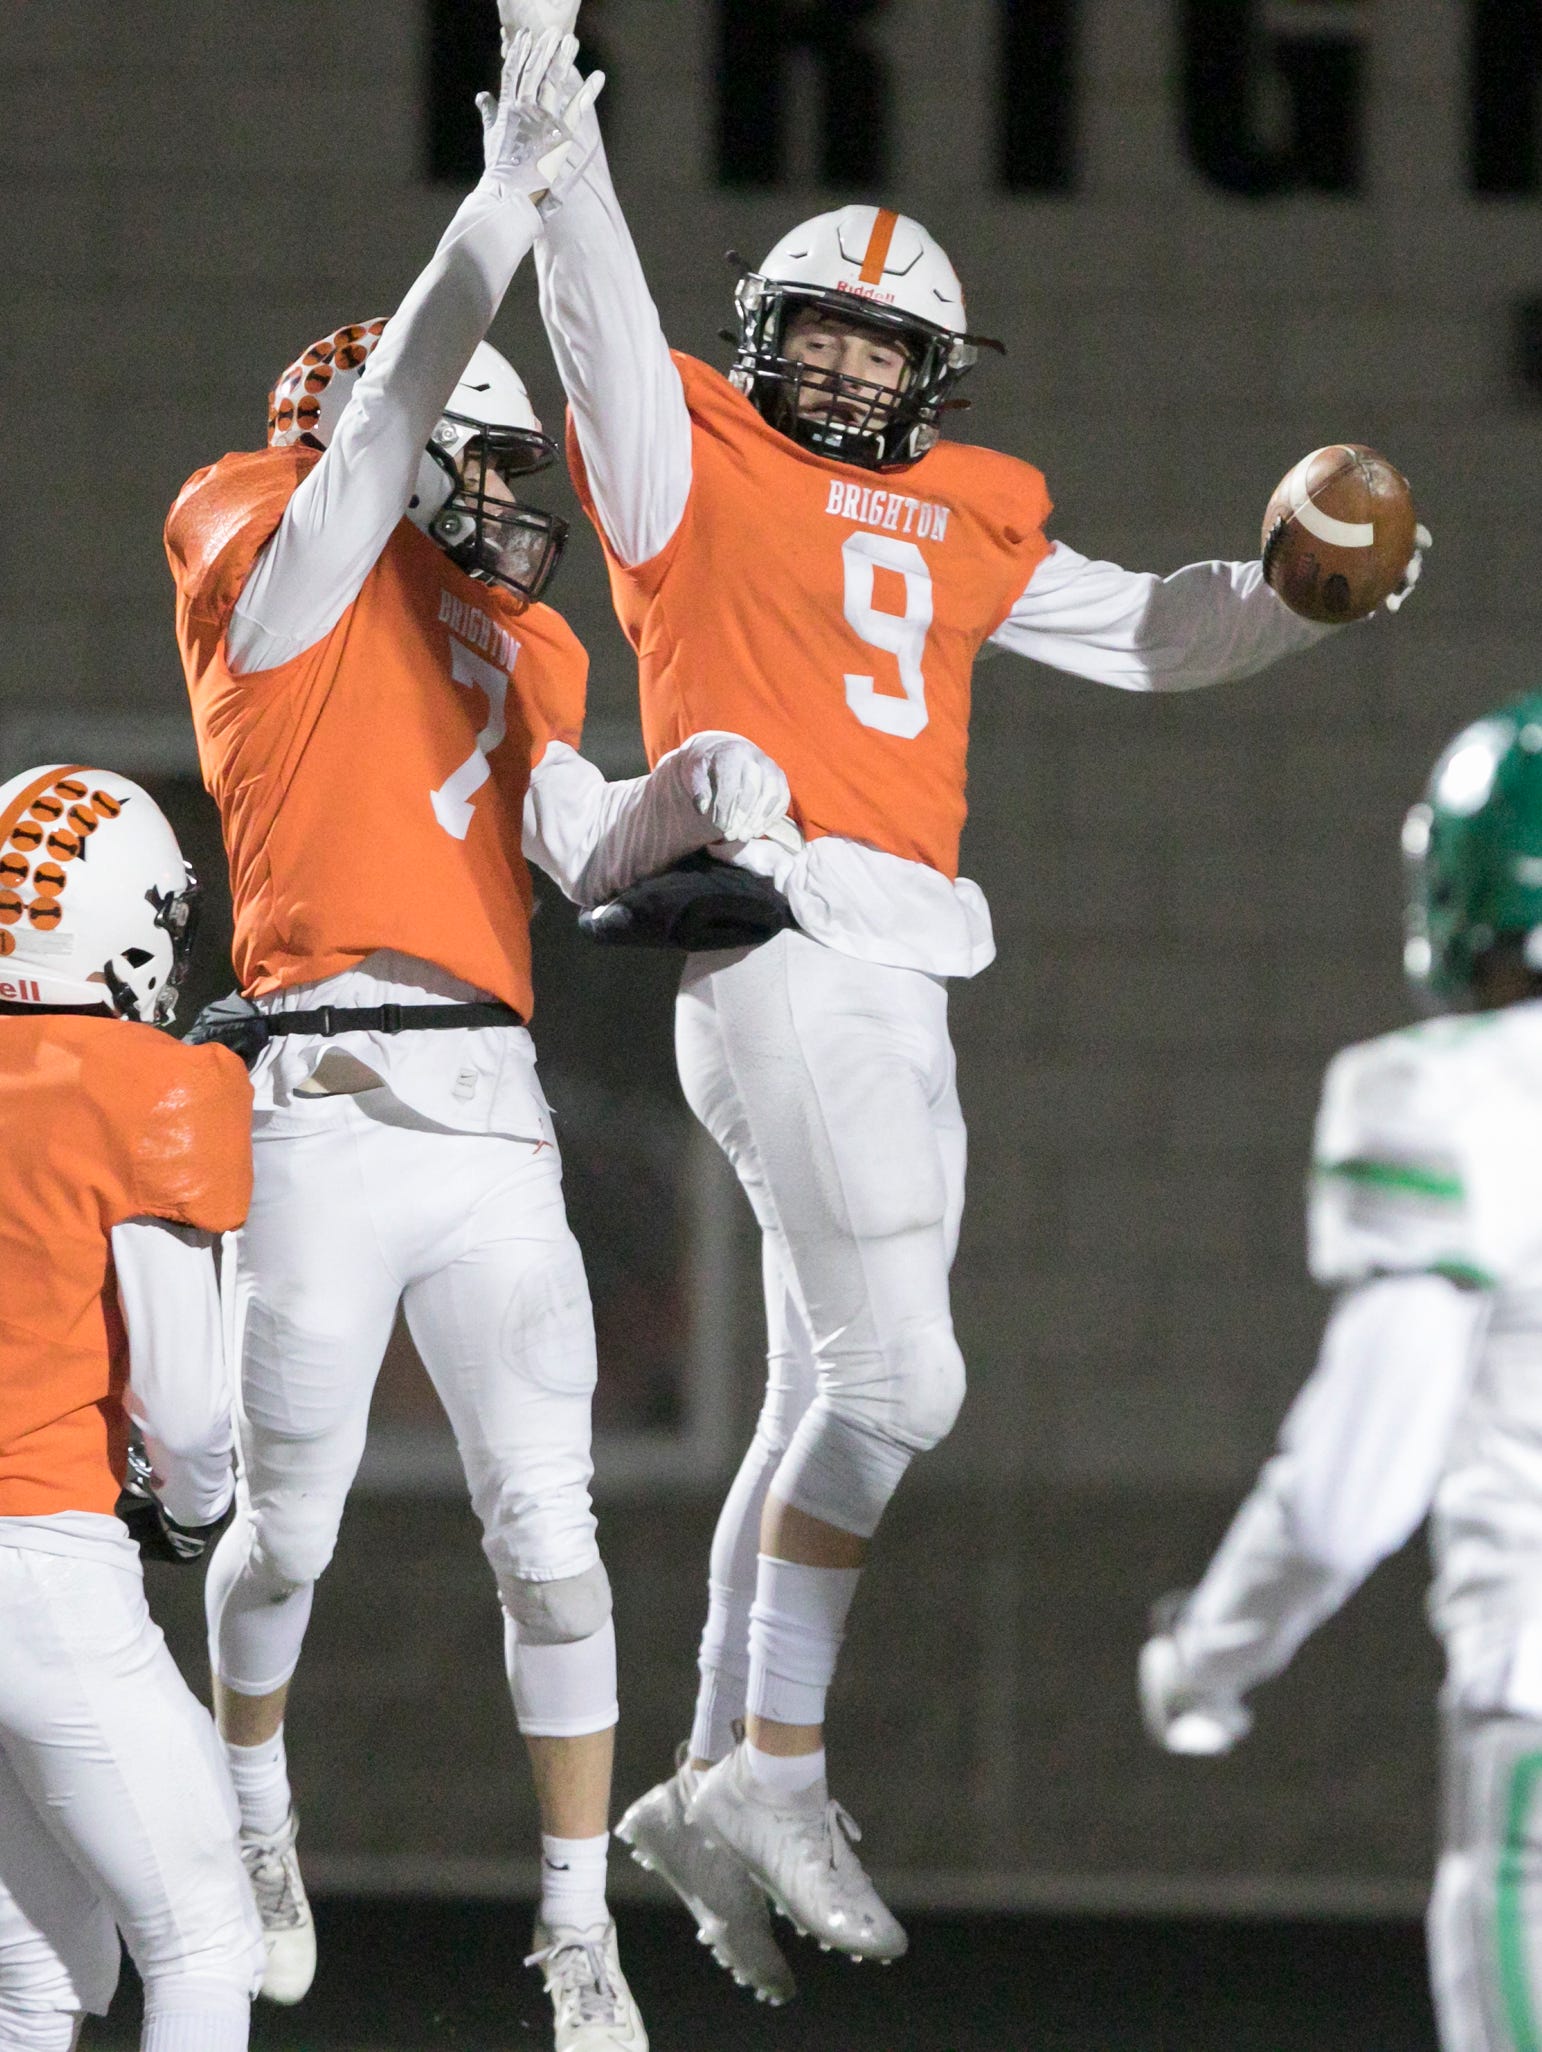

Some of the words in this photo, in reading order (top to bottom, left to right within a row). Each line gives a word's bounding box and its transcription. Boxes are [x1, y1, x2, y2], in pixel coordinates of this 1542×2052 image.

[825, 479, 950, 542] BRIGHTON
[438, 588, 522, 672] BRIGHTON
[841, 530, 934, 740] 9
[429, 633, 509, 840] 7
